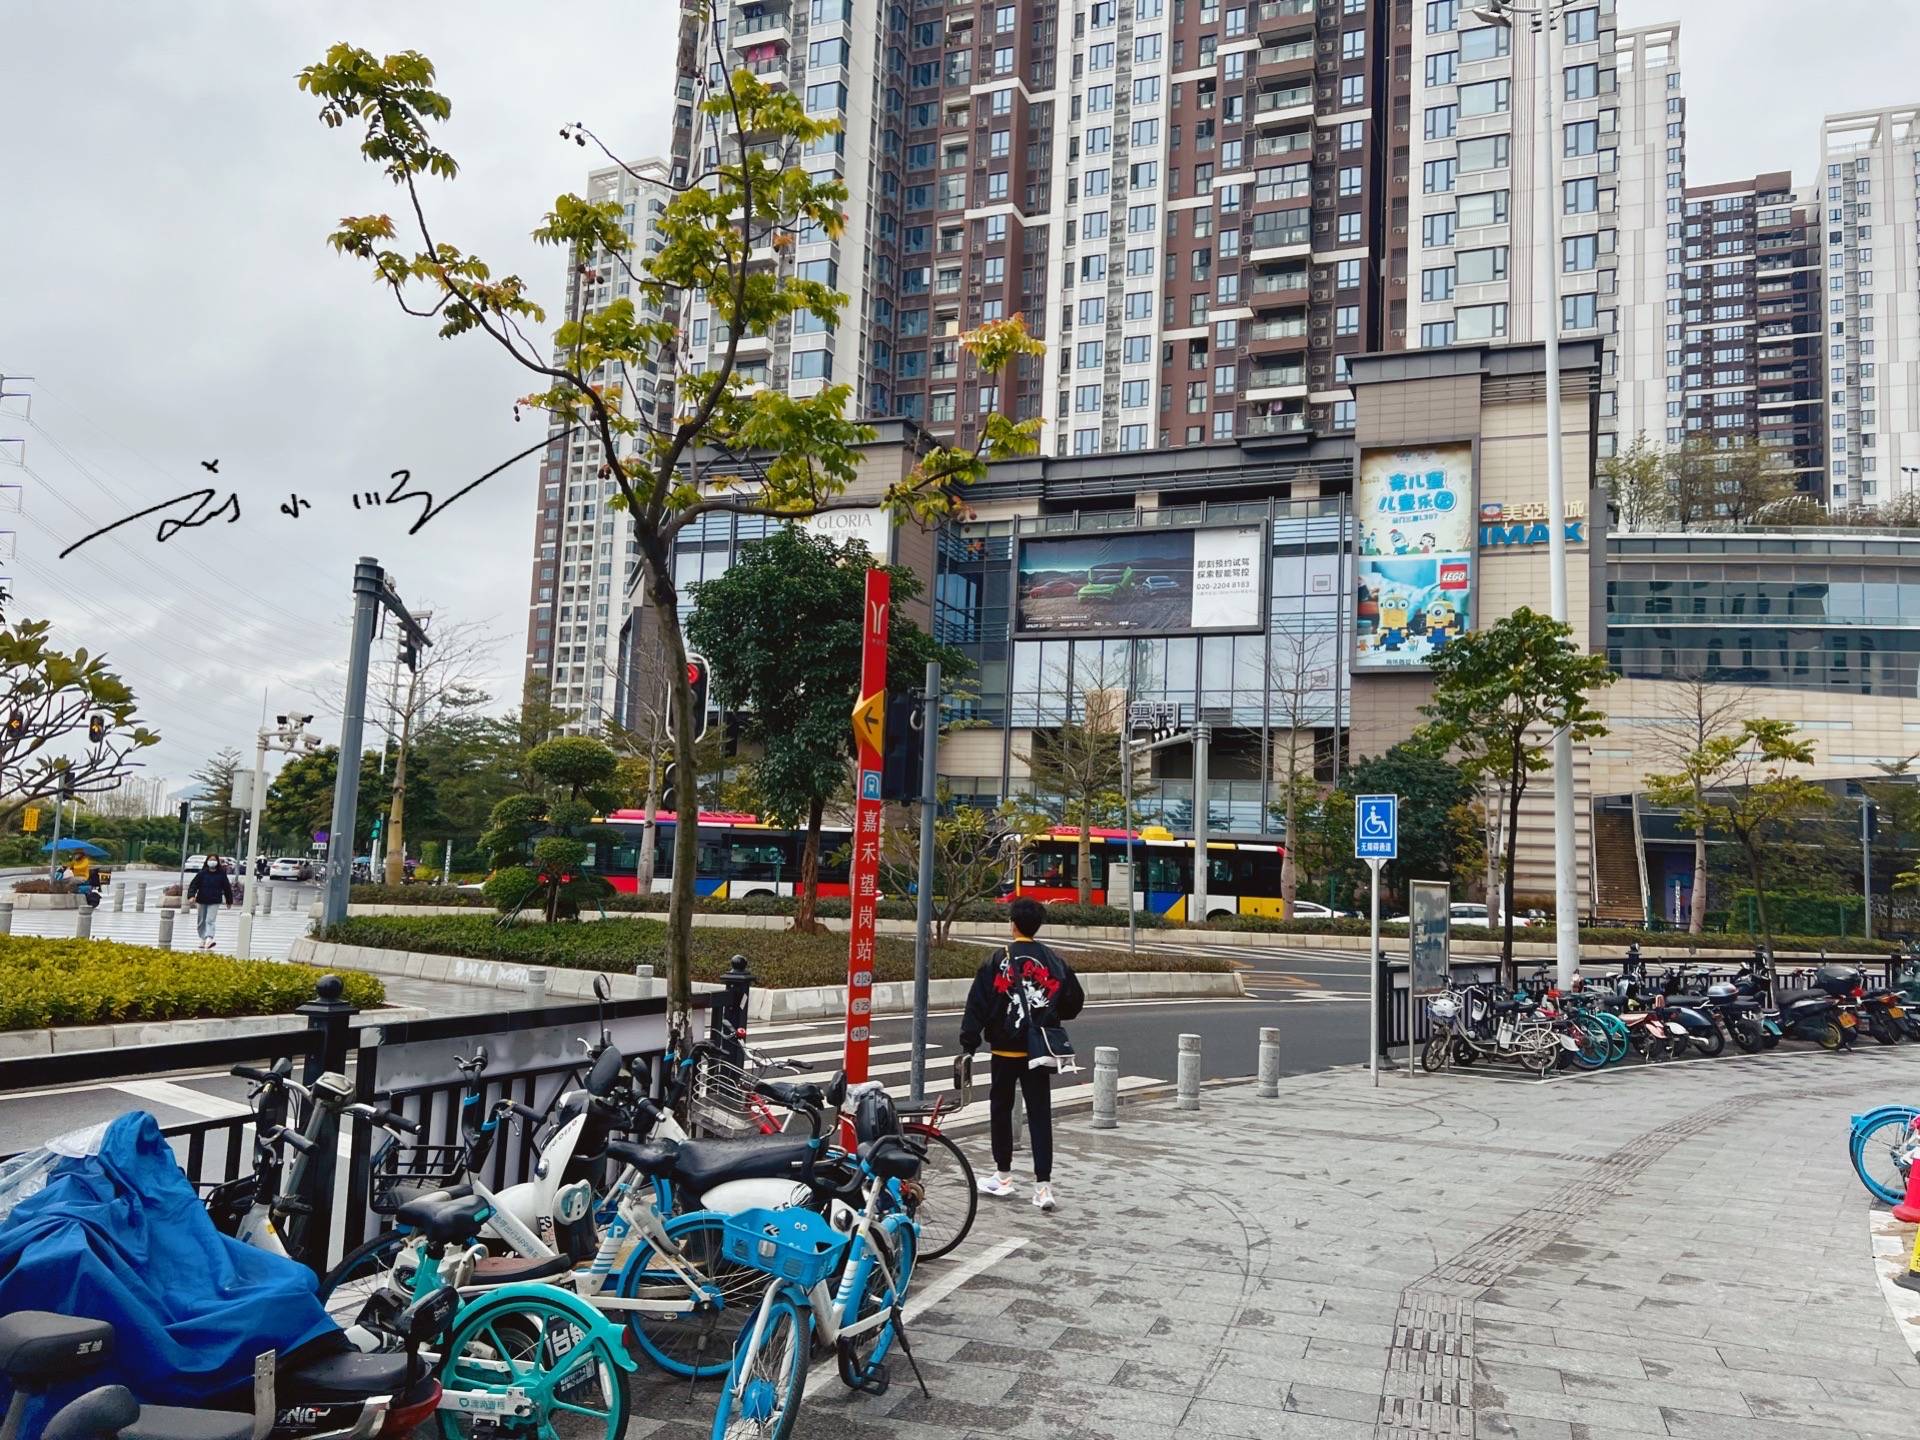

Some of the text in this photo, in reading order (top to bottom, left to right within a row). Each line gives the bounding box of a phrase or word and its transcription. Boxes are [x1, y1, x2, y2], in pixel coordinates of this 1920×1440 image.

[1503, 500, 1585, 520] 美亞城
[816, 513, 872, 529] GLORIA
[1442, 571, 1465, 581] LEGO
[856, 809, 878, 961] 嘉禾望岗站
